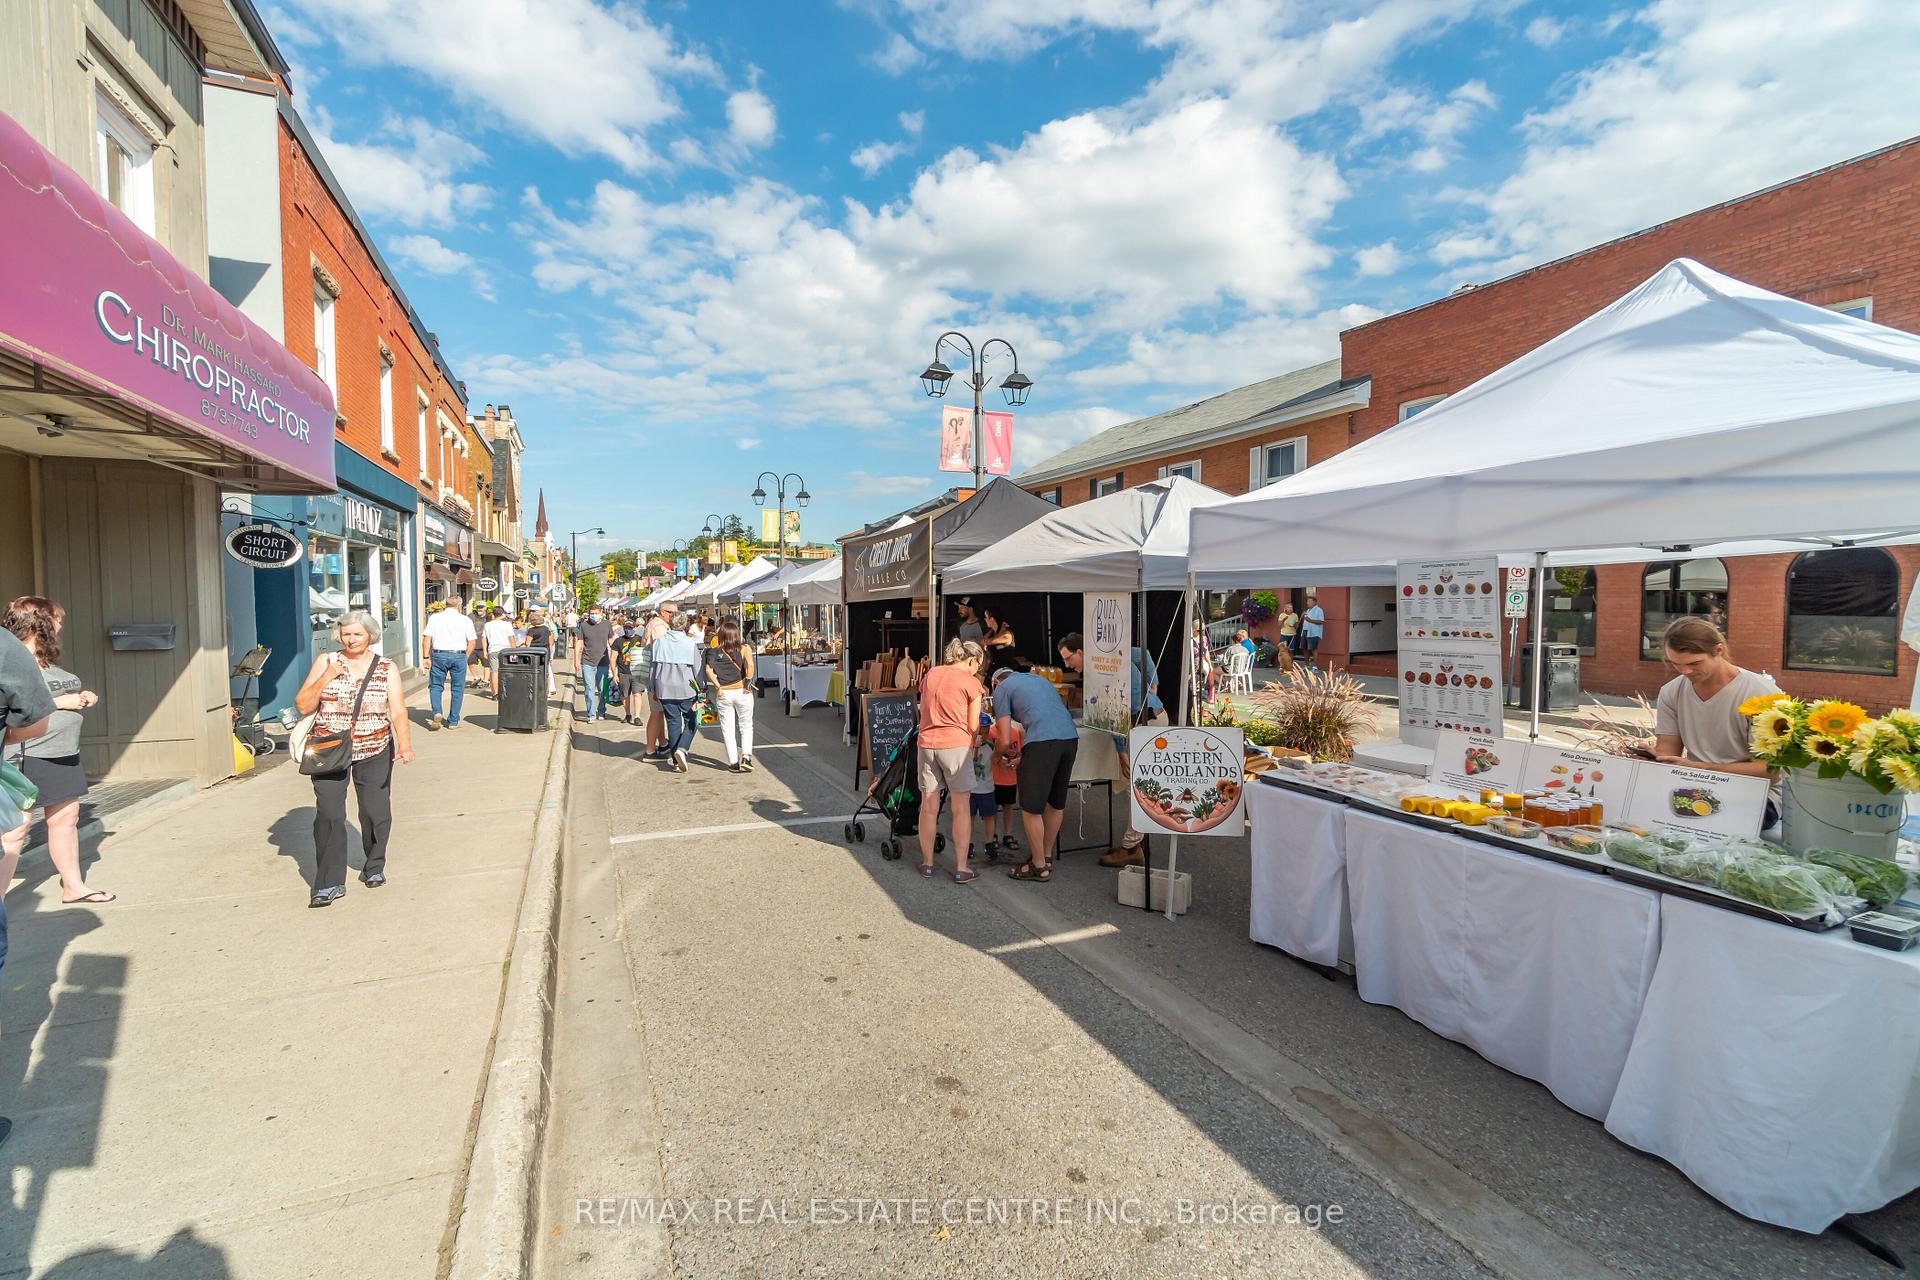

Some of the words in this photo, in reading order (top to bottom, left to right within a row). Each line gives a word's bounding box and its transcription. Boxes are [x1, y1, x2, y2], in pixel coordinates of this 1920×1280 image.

[161, 304, 190, 340] DR.
[191, 324, 231, 366] MARK
[231, 351, 282, 398] HASSARD
[95, 290, 311, 445] CHIROPRACTOR
[244, 534, 287, 549] SHORT
[240, 545, 288, 560] CIRCUIT
[867, 572, 890, 585] TABLE
[1152, 751, 1223, 765] EASTERN
[1560, 751, 1575, 759] Miso
[1575, 754, 1602, 764] Dressing
[1138, 764, 1238, 778] WOODLANDS
[1689, 771, 1710, 780] Salad
[1711, 774, 1730, 783] Bowl
[1166, 777, 1198, 786] TRADING
